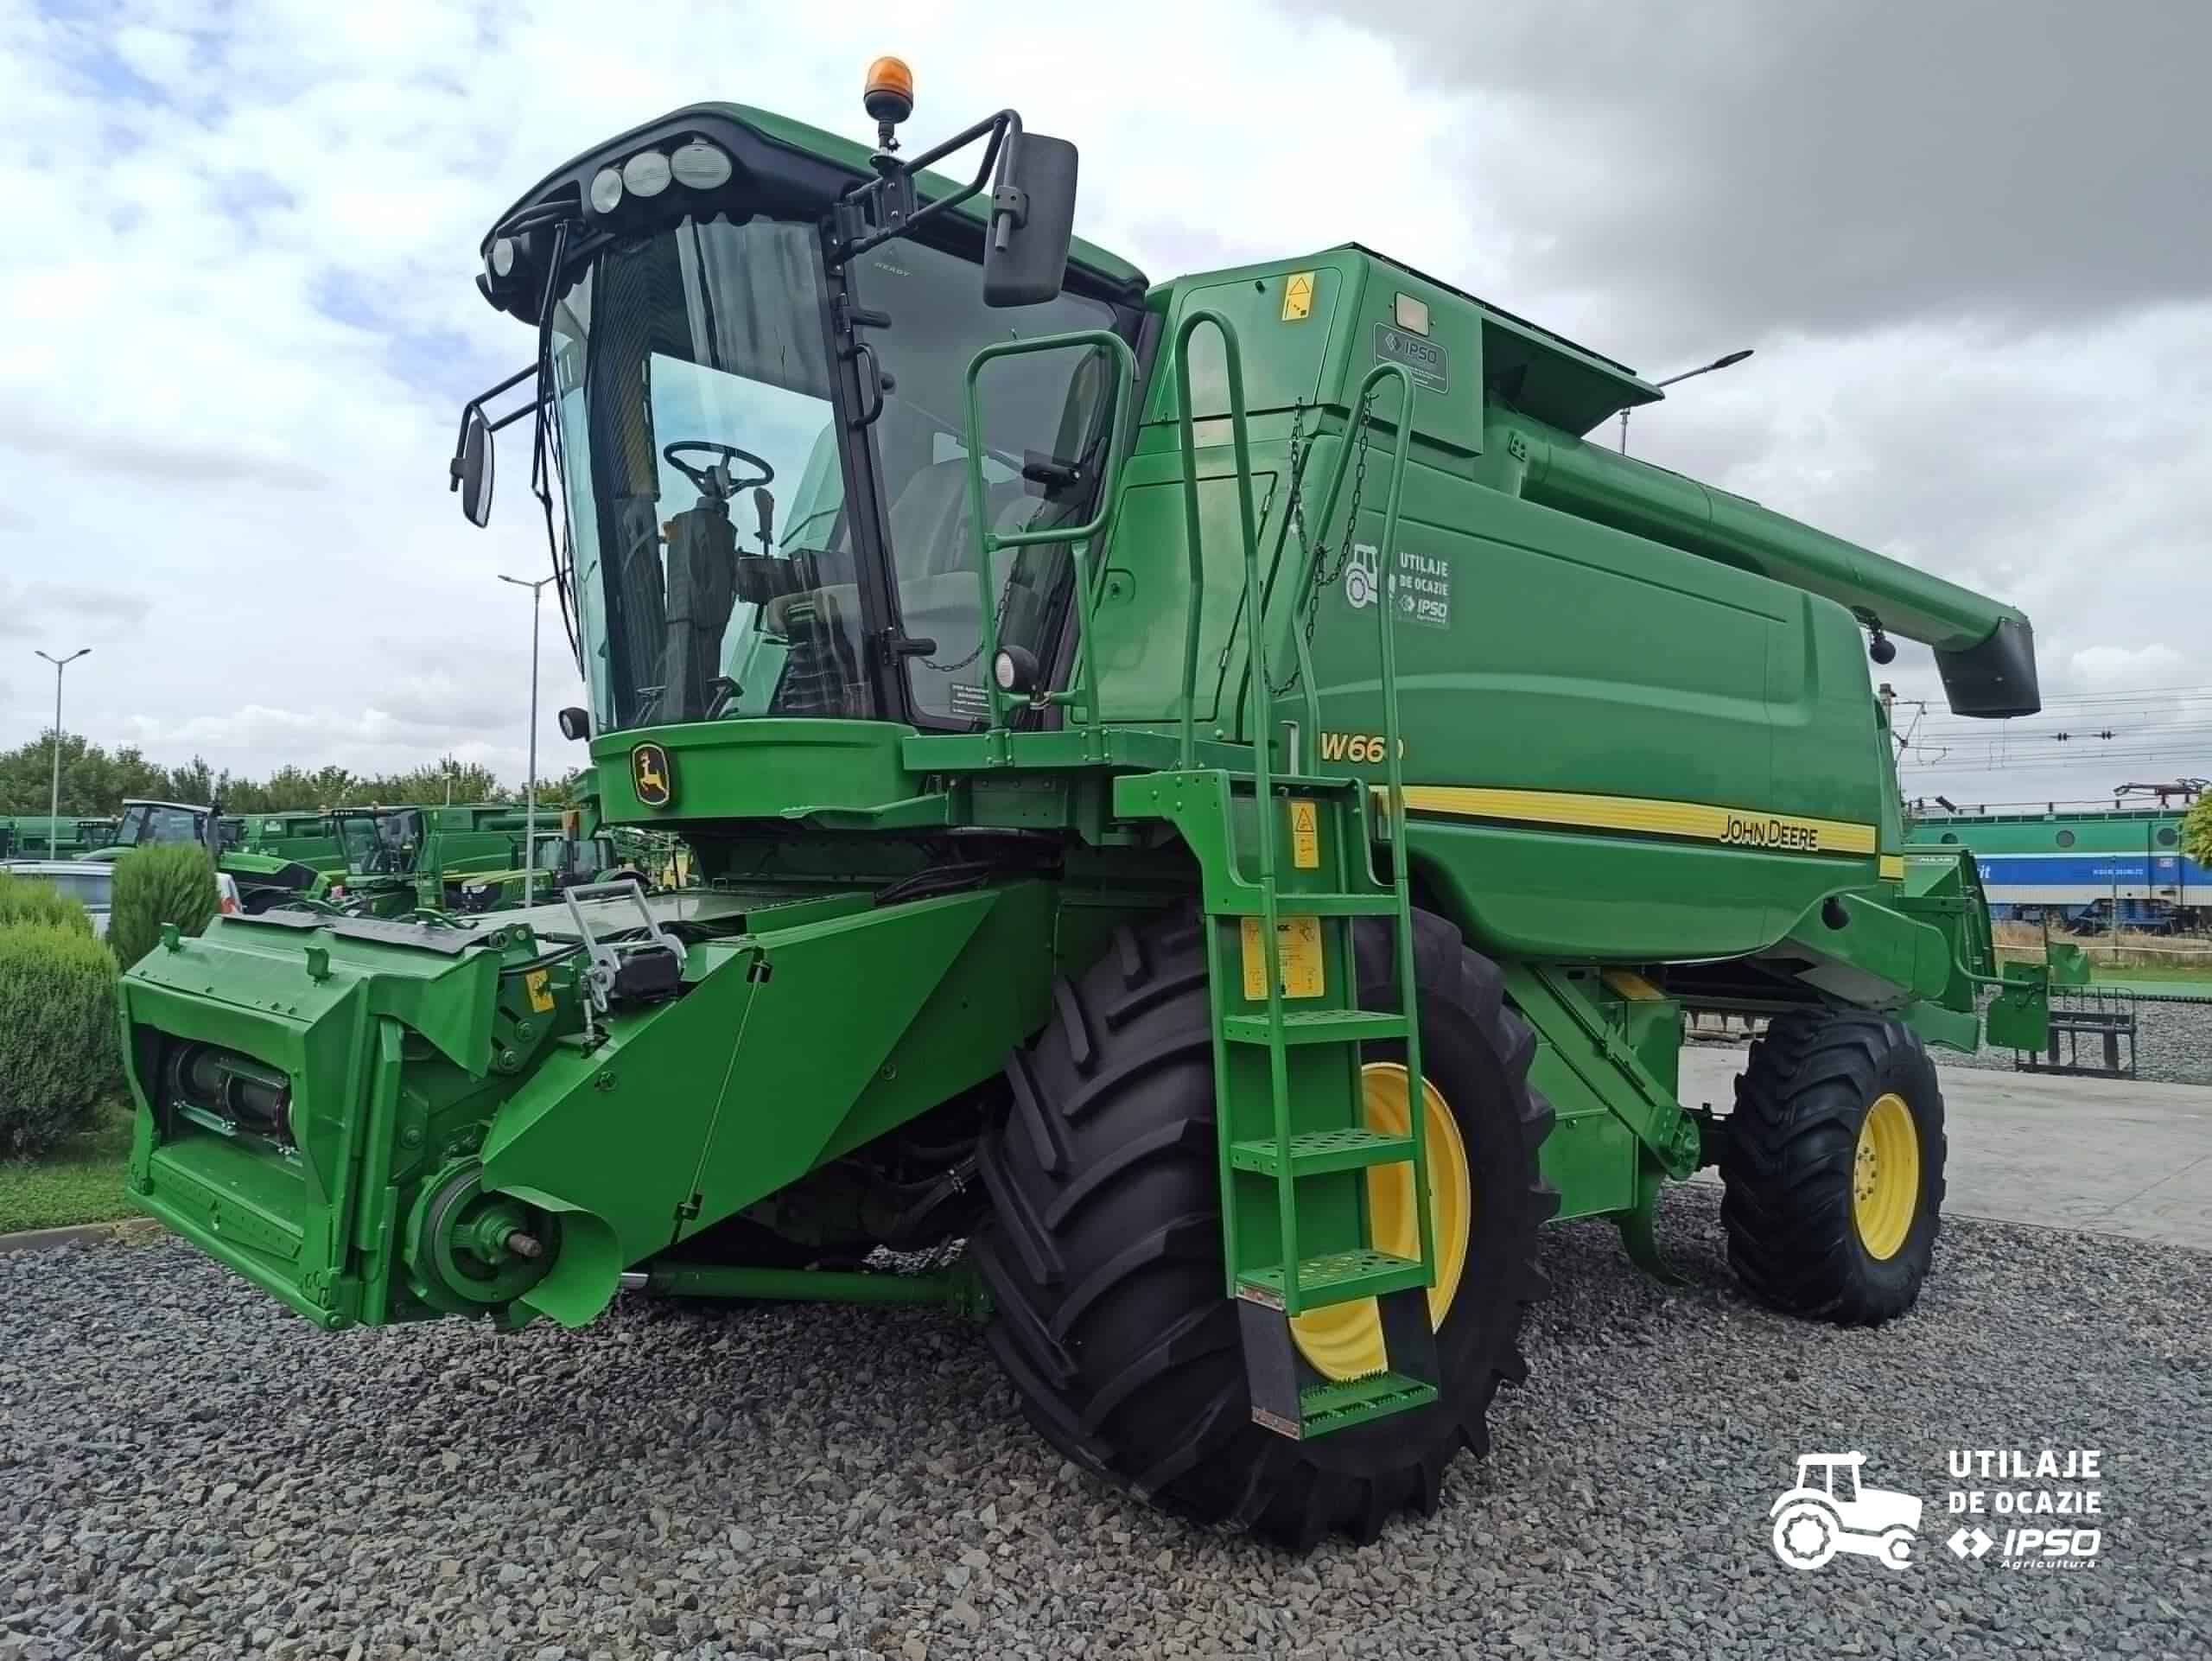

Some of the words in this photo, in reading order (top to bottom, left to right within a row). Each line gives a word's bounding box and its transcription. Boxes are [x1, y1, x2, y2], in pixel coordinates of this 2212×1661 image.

[1404, 341, 1437, 364] IPSO
[1400, 552, 1449, 577] UTILAJE
[1400, 574, 1413, 589] DE
[1414, 577, 1449, 596] OCAZIE
[1417, 598, 1447, 618] IPSO
